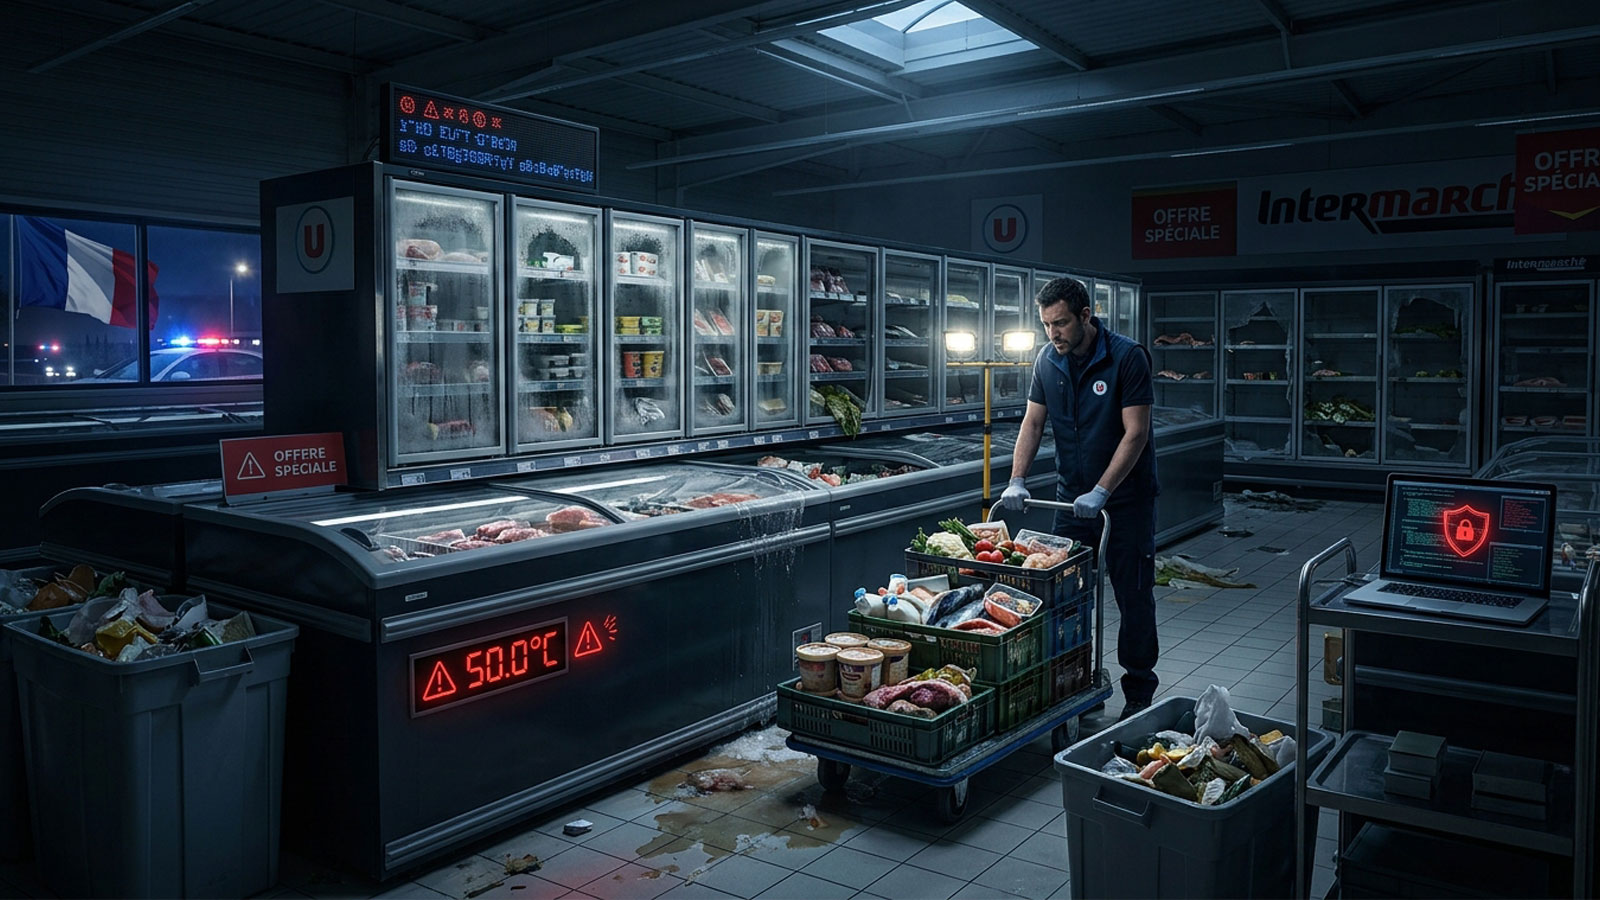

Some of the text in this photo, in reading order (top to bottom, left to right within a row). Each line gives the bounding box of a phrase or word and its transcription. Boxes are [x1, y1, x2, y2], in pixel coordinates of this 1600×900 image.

[1153, 205, 1212, 225] OFFRE
[304, 223, 325, 259] U
[994, 217, 1017, 243] U
[1144, 223, 1221, 243] SPÉCIALE
[274, 447, 327, 463] OFFERE
[466, 630, 558, 689] 50.0°C
